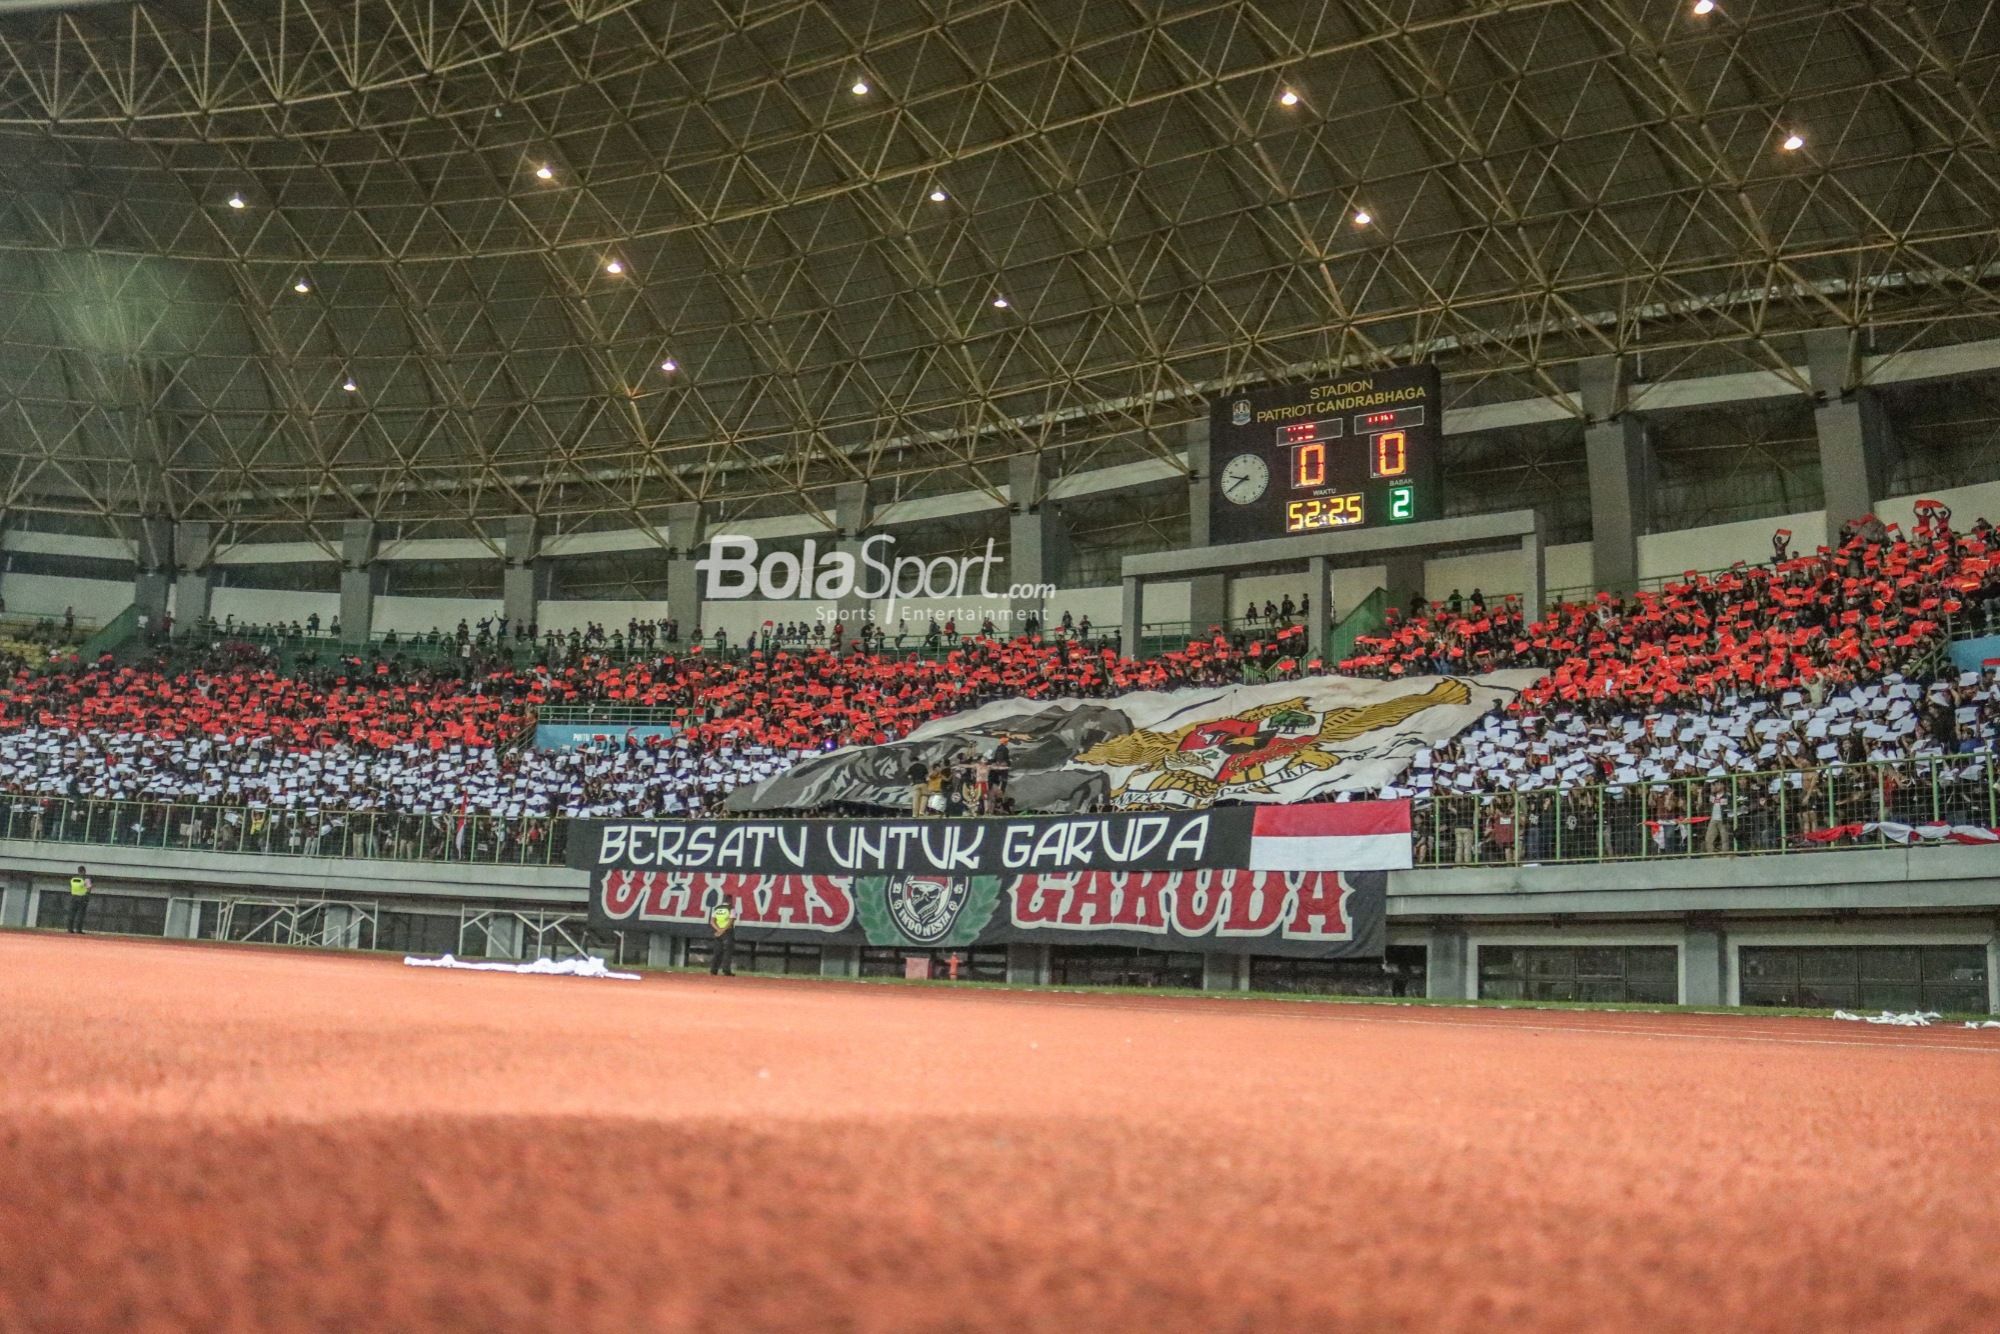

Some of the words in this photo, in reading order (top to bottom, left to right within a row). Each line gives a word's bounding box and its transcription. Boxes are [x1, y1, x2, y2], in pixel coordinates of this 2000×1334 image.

[1256, 403, 1314, 423] PATRIOT
[1316, 386, 1426, 414] CANDRABHAGA
[1310, 379, 1373, 399] STADION
[1300, 444, 1325, 486] 0
[1379, 432, 1406, 476] 0
[1313, 488, 1336, 496] WAKTU
[1393, 489, 1410, 518] 2
[1289, 496, 1362, 530] 52:25
[600, 825, 807, 868] BERSATU
[827, 825, 984, 871] UNTUK
[1002, 815, 1210, 869] GARUDA
[1006, 868, 1355, 941] GARUDA
[899, 910, 951, 937] INDONESIA
